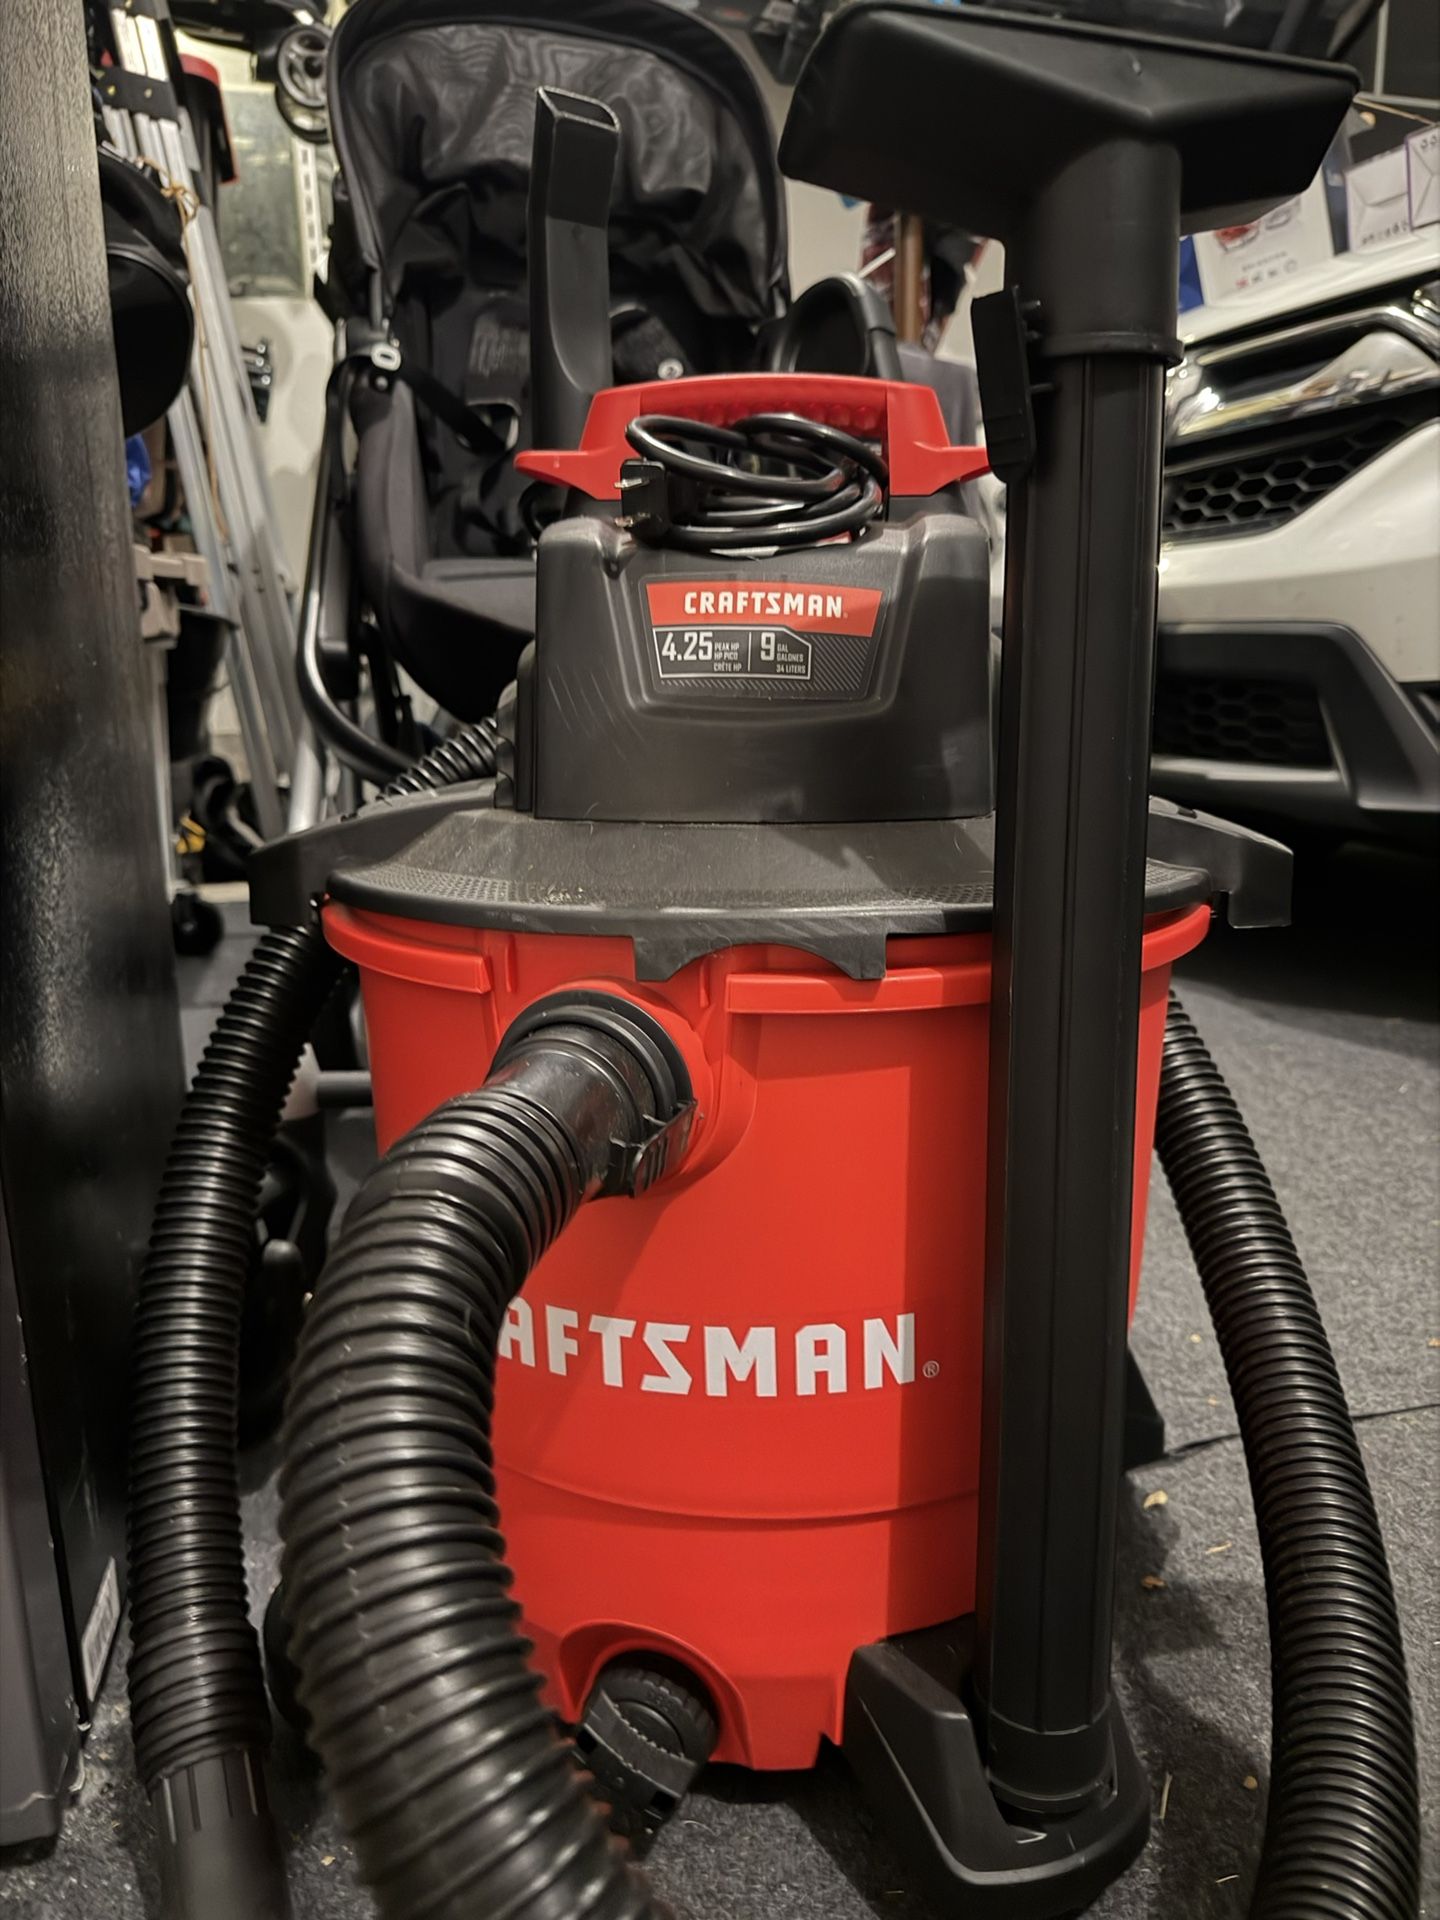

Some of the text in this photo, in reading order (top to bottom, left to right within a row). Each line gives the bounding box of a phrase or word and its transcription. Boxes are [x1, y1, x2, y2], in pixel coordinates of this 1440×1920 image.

[684, 591, 843, 619] CRAFTSMAN
[661, 631, 713, 661] 4.25
[714, 641, 740, 652] PEAK HP
[760, 632, 776, 661] 9
[777, 643, 789, 653] GAL
[714, 652, 738, 661] HP PICO
[776, 653, 803, 663] GALONES
[733, 663, 742, 672] HP
[776, 664, 806, 674] 34 LITERS
